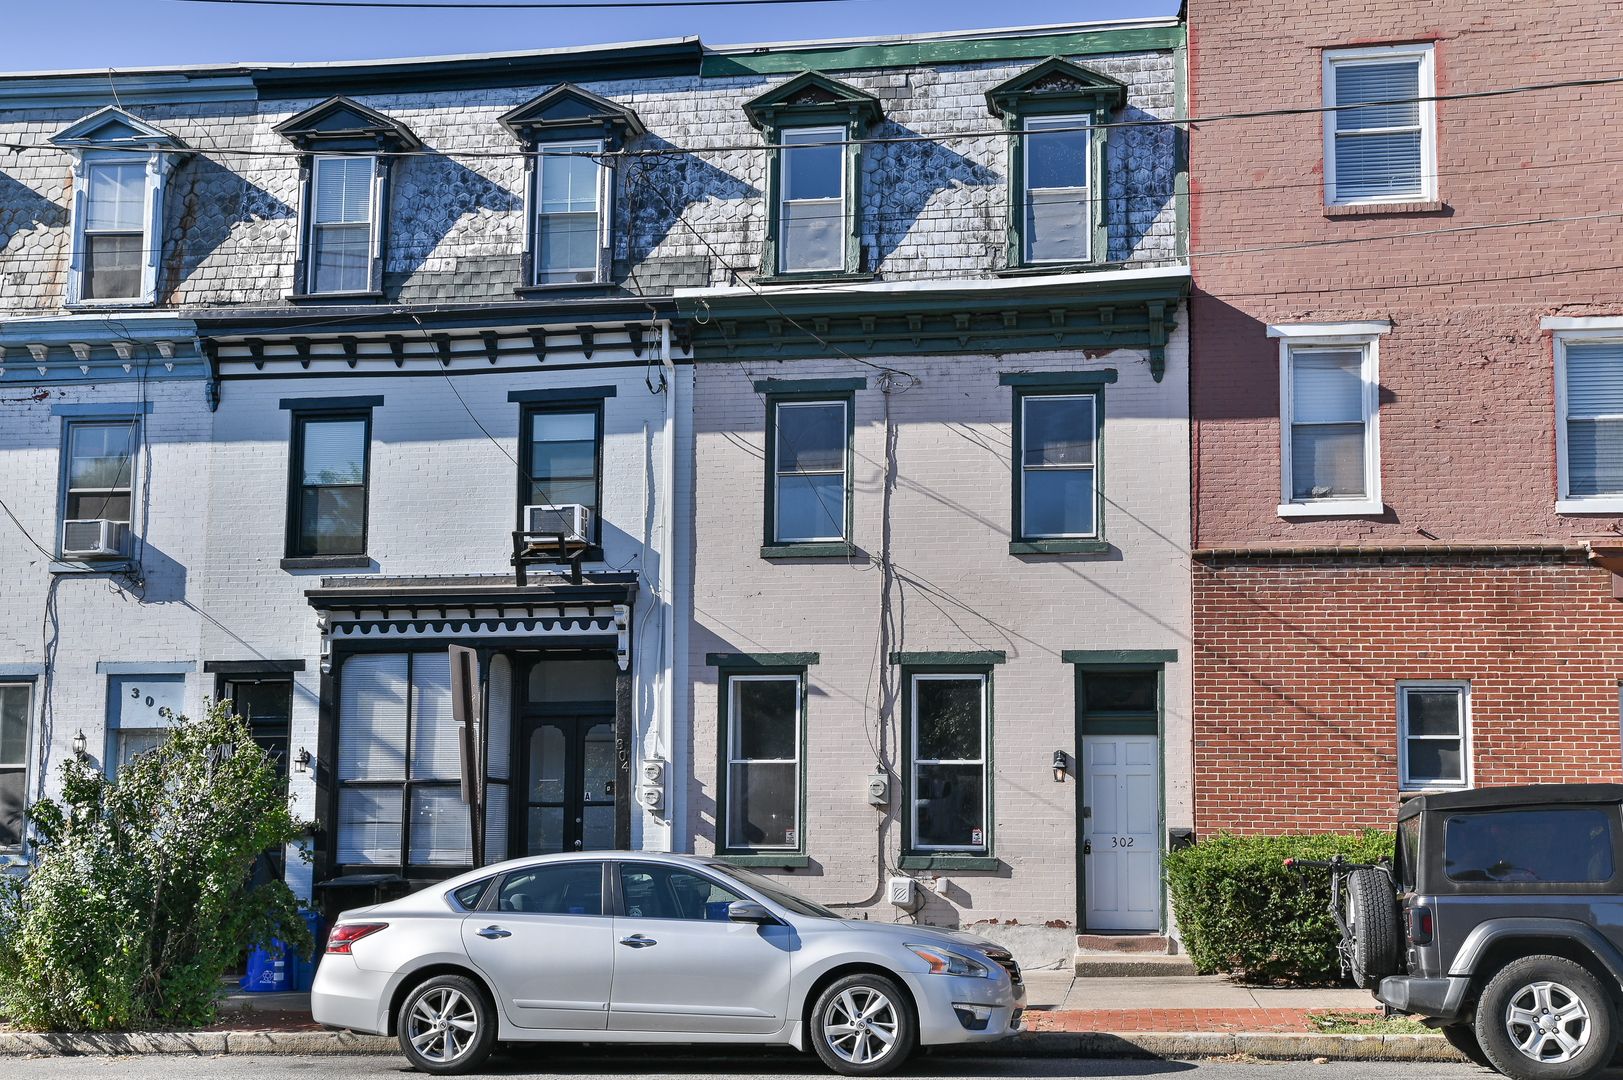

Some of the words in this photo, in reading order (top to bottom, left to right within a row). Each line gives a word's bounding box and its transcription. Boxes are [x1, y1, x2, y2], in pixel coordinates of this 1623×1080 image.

[131, 687, 167, 717] 306
[616, 738, 629, 773] 304
[585, 792, 591, 800] A
[1111, 836, 1134, 848] 302
